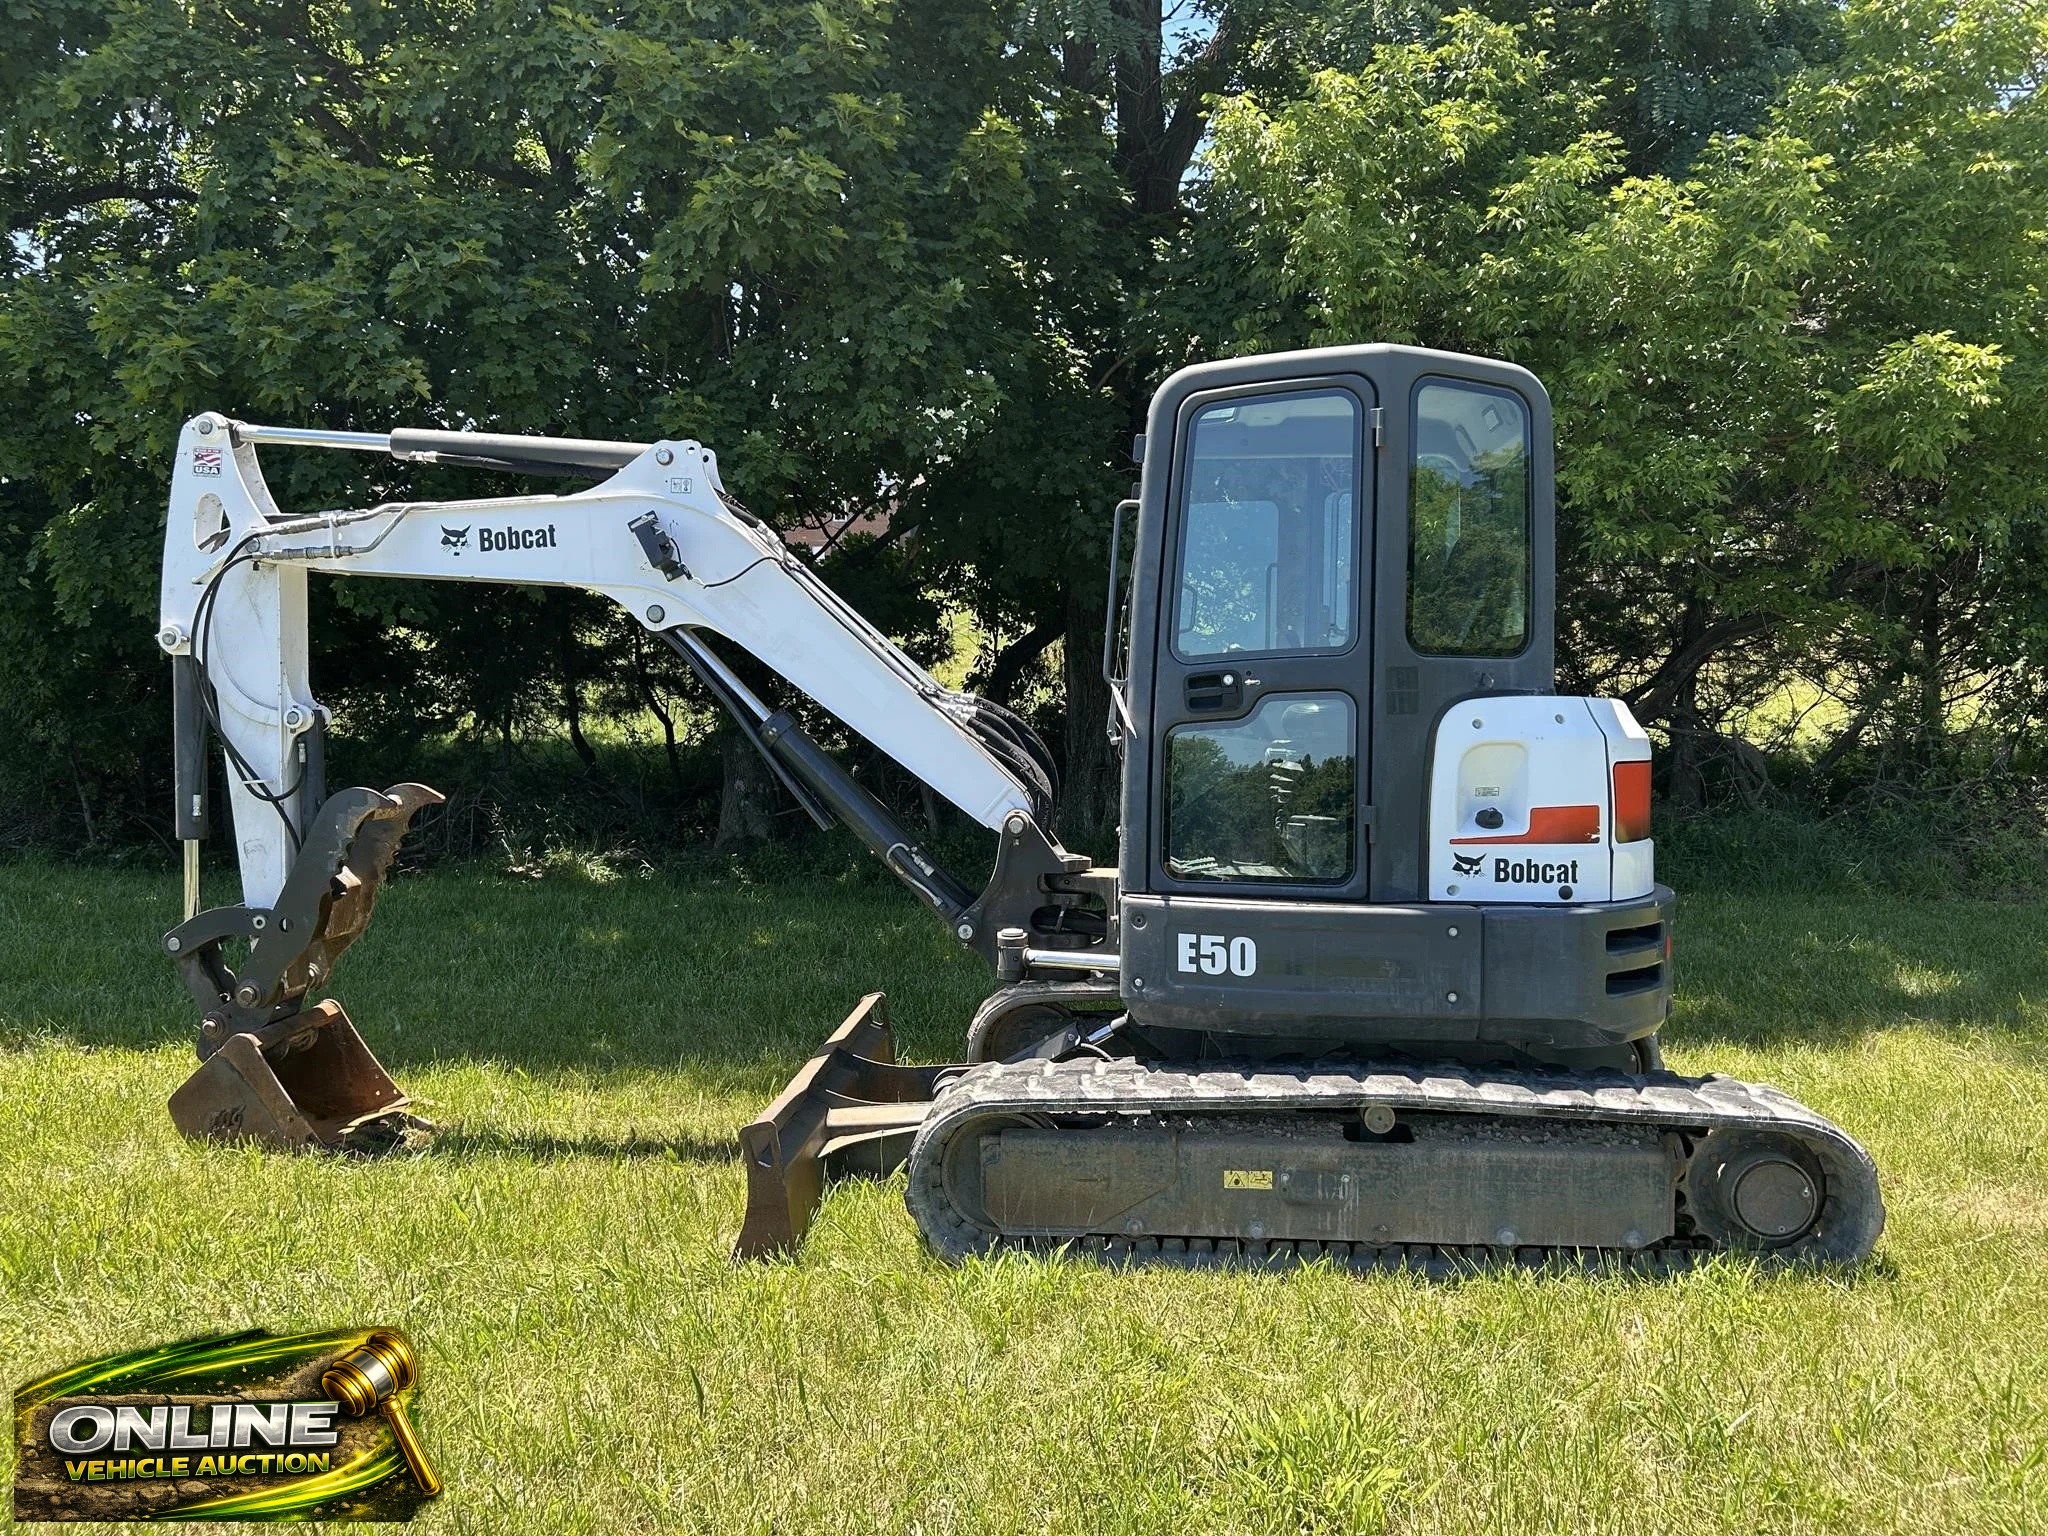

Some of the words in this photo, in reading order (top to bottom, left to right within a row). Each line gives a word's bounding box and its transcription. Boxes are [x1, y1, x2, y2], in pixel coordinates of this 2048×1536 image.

[195, 466, 219, 474] USA
[479, 524, 556, 552] Bobcat
[1494, 858, 1578, 883] Bobcat
[1178, 933, 1256, 977] E50
